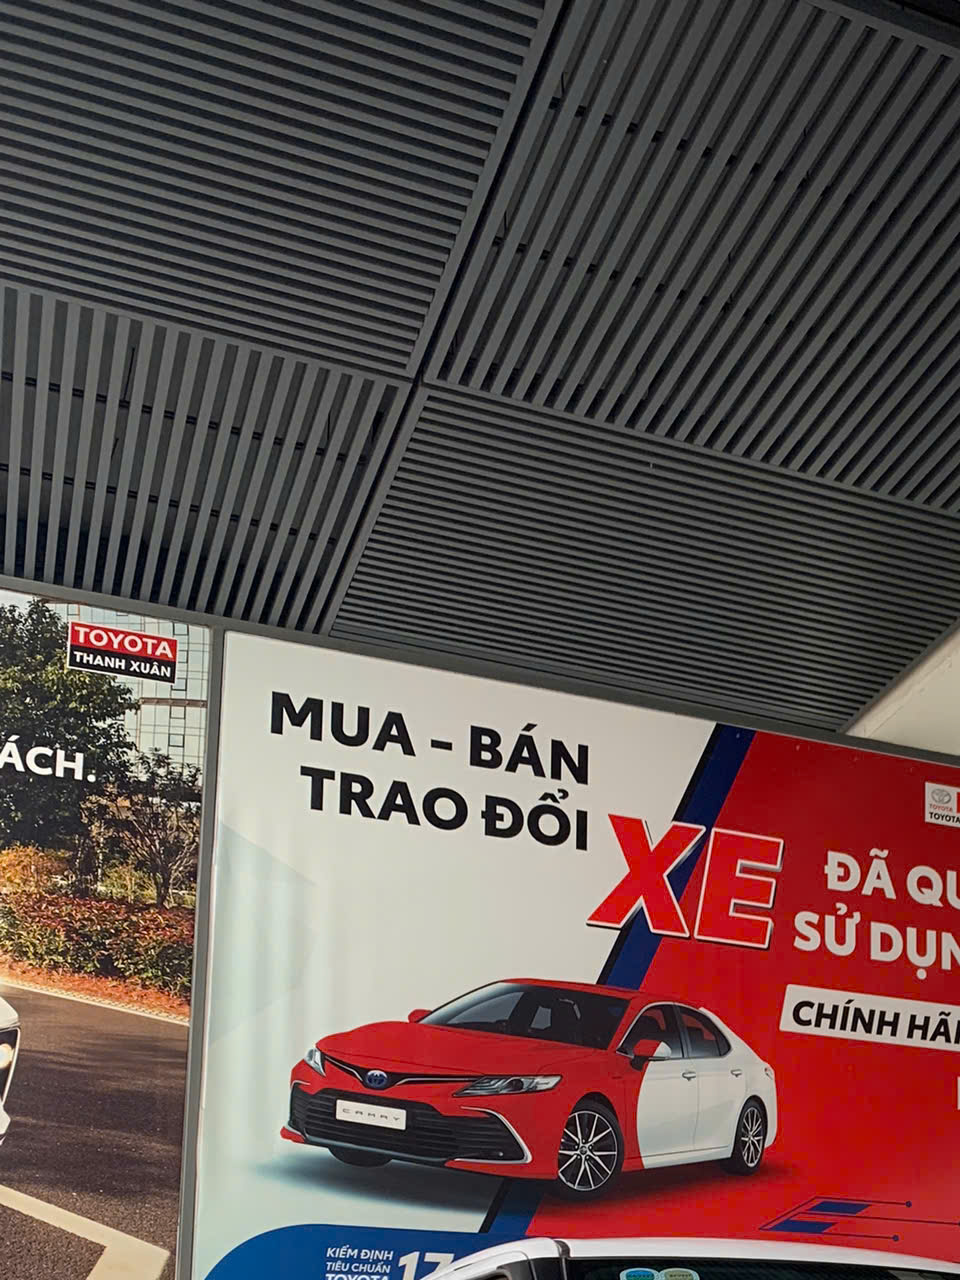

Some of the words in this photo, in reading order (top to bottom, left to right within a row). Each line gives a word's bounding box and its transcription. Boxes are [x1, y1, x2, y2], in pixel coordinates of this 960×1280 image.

[74, 626, 174, 659] TOYOTA
[73, 651, 126, 670] THANH
[129, 660, 171, 678] XUÂN
[270, 690, 416, 757] MUA
[469, 722, 589, 785] BÁN
[299, 765, 469, 831] TRAO
[481, 788, 588, 851] ĐỔI
[929, 811, 960, 824] TOYOTA
[585, 812, 785, 950] XE
[824, 848, 896, 900] ĐÃ
[793, 902, 861, 957] SỬ
[792, 999, 900, 1037] CHÍNH
[326, 1244, 358, 1259] KIỂM
[360, 1249, 394, 1262] ĐỊNH
[326, 1260, 350, 1272] TIÊU
